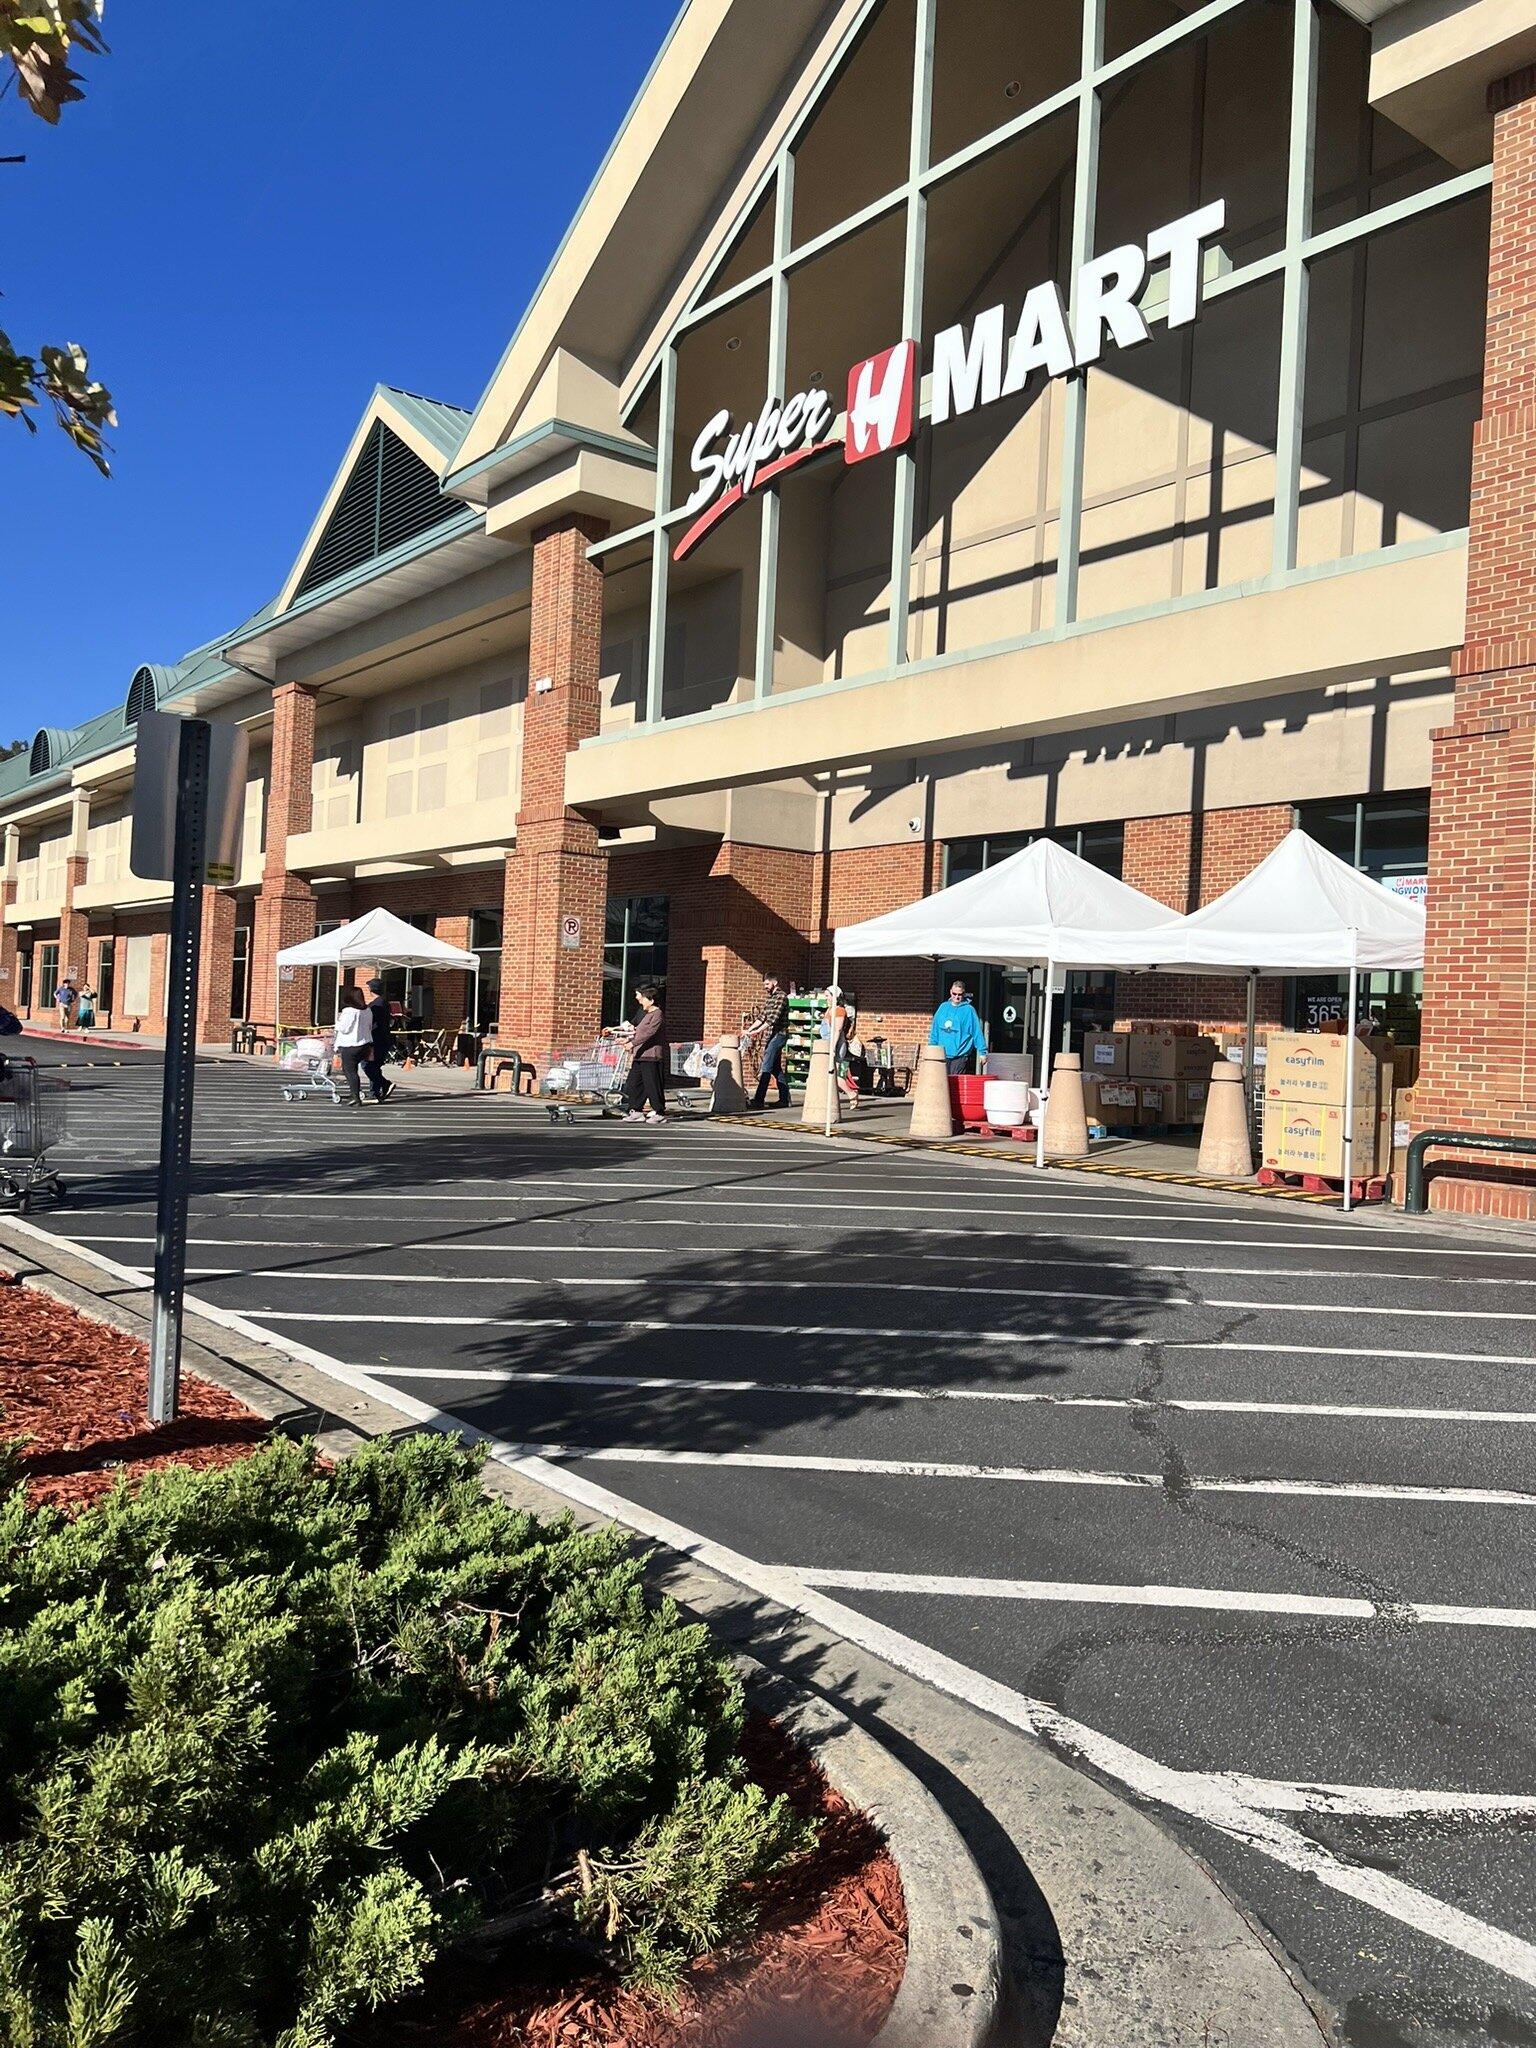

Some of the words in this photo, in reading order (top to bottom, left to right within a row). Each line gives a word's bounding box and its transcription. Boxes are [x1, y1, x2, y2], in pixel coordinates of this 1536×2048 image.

[686, 388, 832, 513] Super
[847, 340, 910, 453] H
[930, 198, 1226, 426] MART
[1405, 878, 1427, 886] MAR
[1307, 1005, 1341, 1025] 365
[1285, 1055, 1325, 1067] easyfilm
[1283, 1125, 1322, 1137] easyfilm
